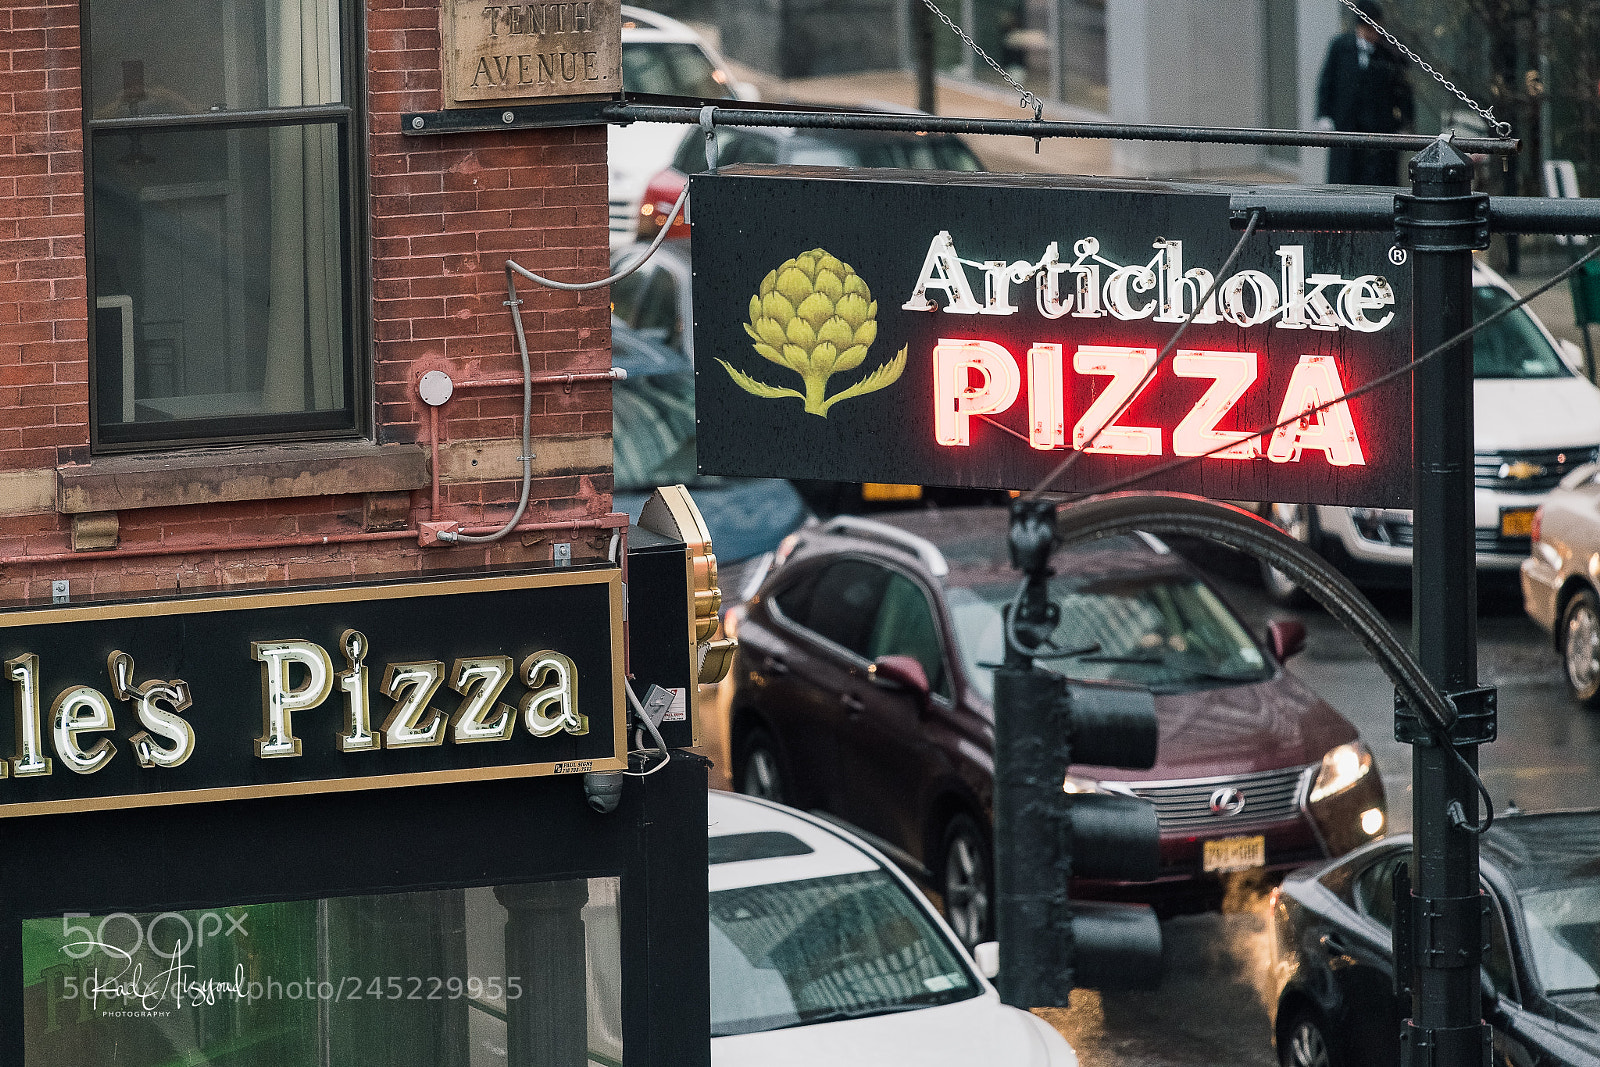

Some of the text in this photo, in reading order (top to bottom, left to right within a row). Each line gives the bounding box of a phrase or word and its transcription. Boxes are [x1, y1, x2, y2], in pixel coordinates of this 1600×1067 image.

[471, 51, 608, 88] AVENUE.
[484, 2, 592, 38] TENTH
[902, 230, 1396, 333] Artichoke
[933, 338, 1367, 467] PIZZA
[0, 628, 589, 779] le's Pizza
